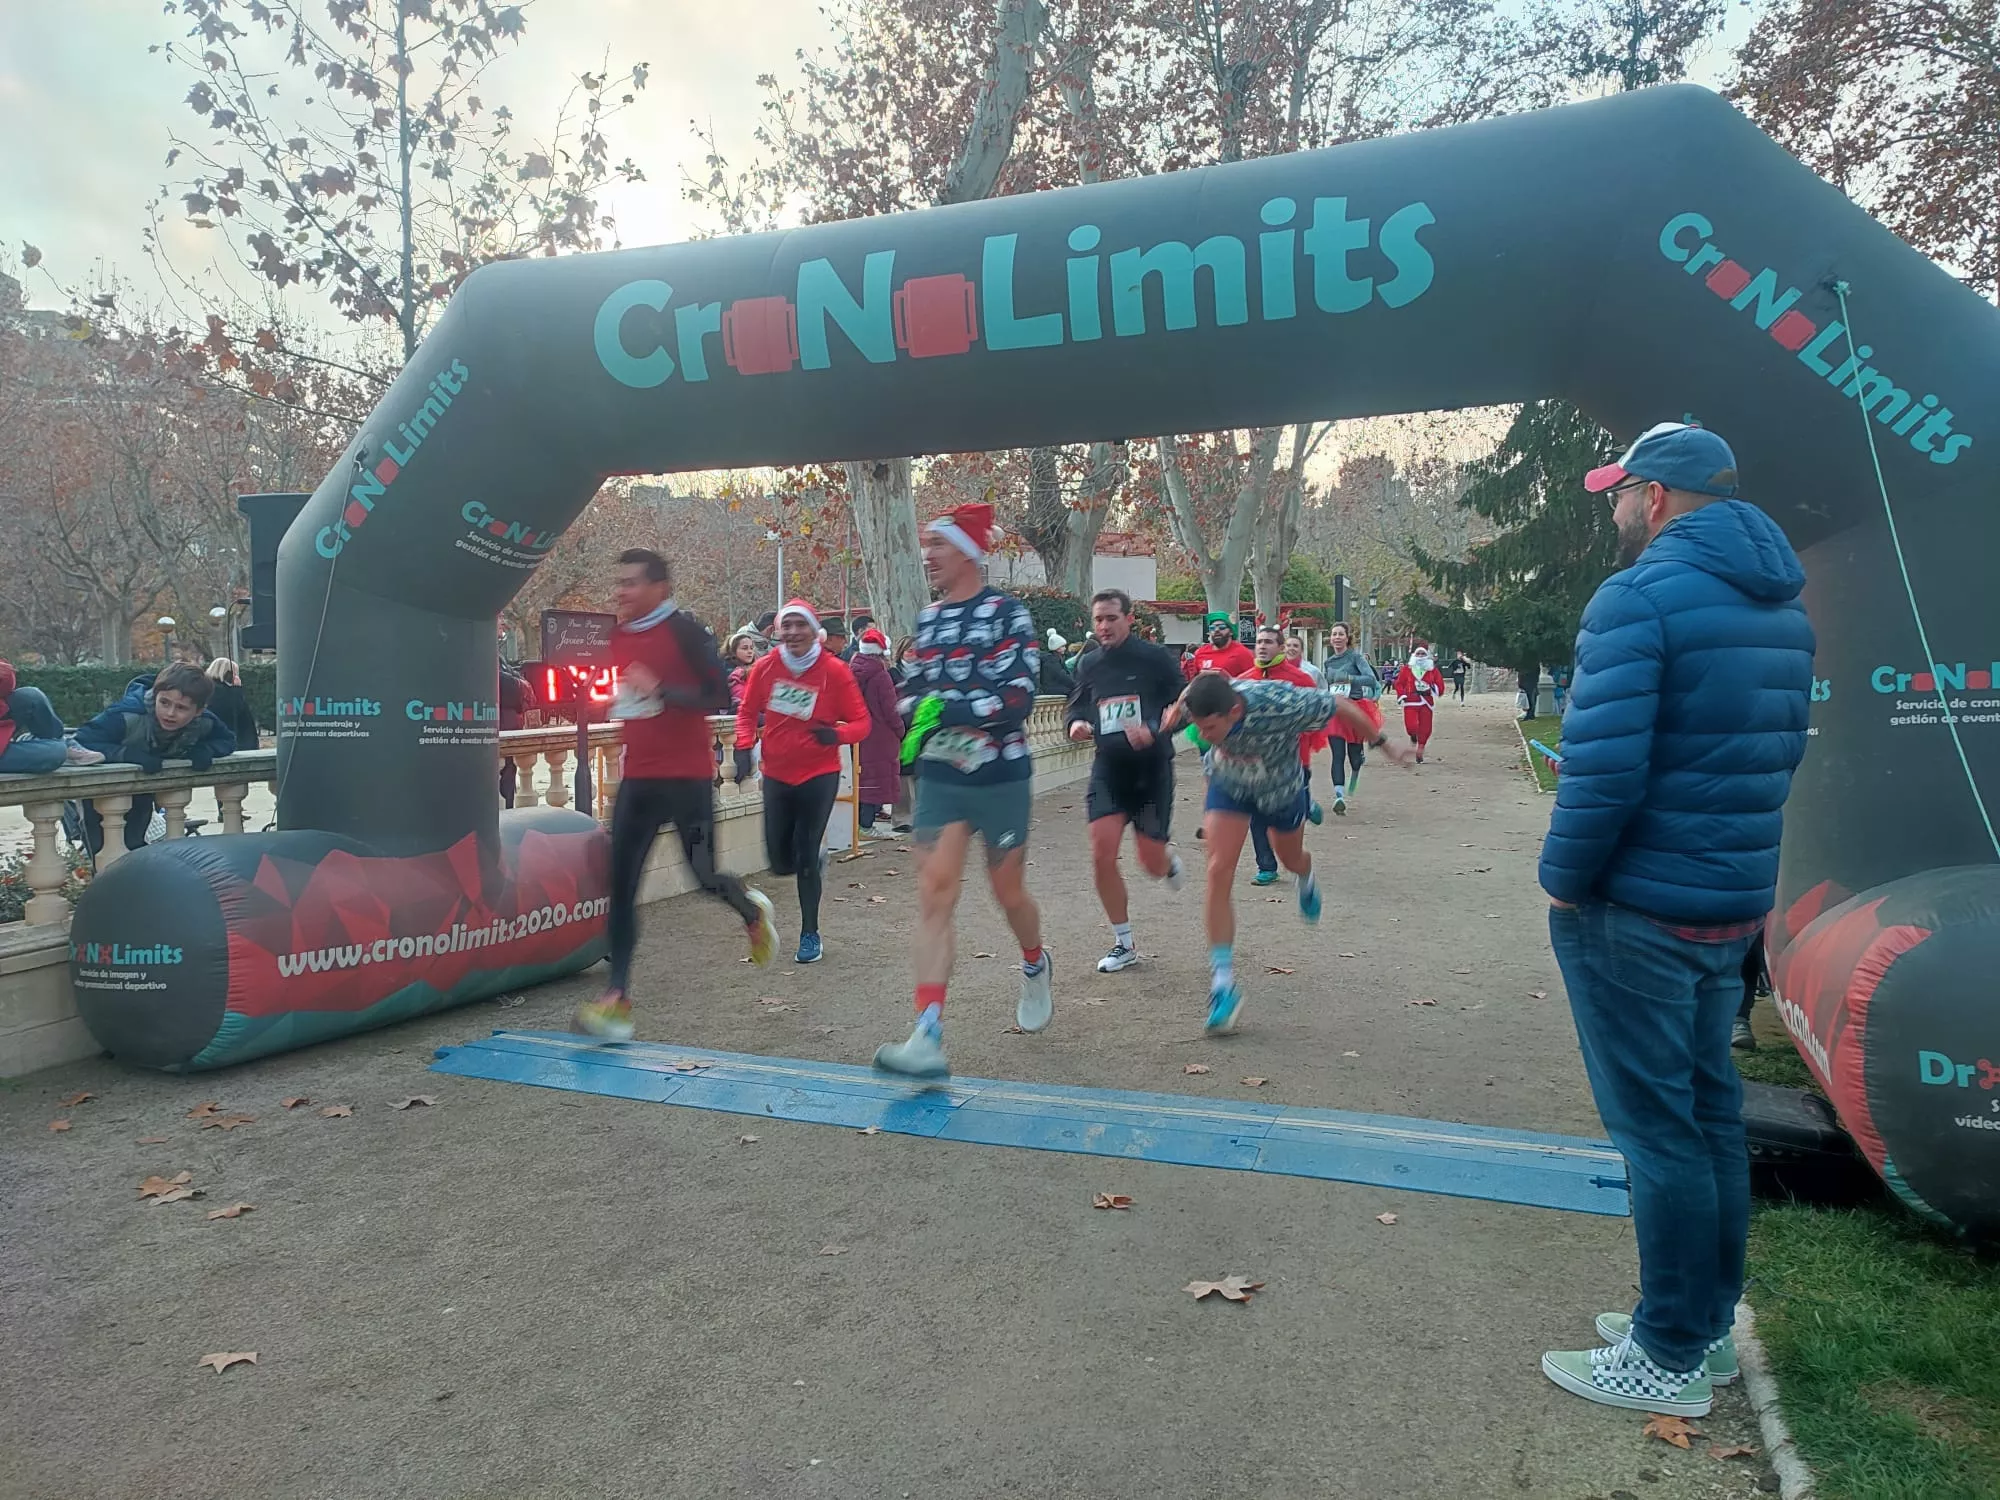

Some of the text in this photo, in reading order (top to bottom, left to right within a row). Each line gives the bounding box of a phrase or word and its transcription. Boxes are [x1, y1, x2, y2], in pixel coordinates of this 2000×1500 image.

[1896, 698, 2000, 710] Servicio de cron
[1105, 702, 1136, 721] 173
[1890, 713, 1937, 726] gestión
[423, 725, 453, 734] Servicio
[418, 736, 448, 745] gestión
[277, 895, 611, 978] www.cronolimits2020.com
[124, 981, 167, 991] deportivo
